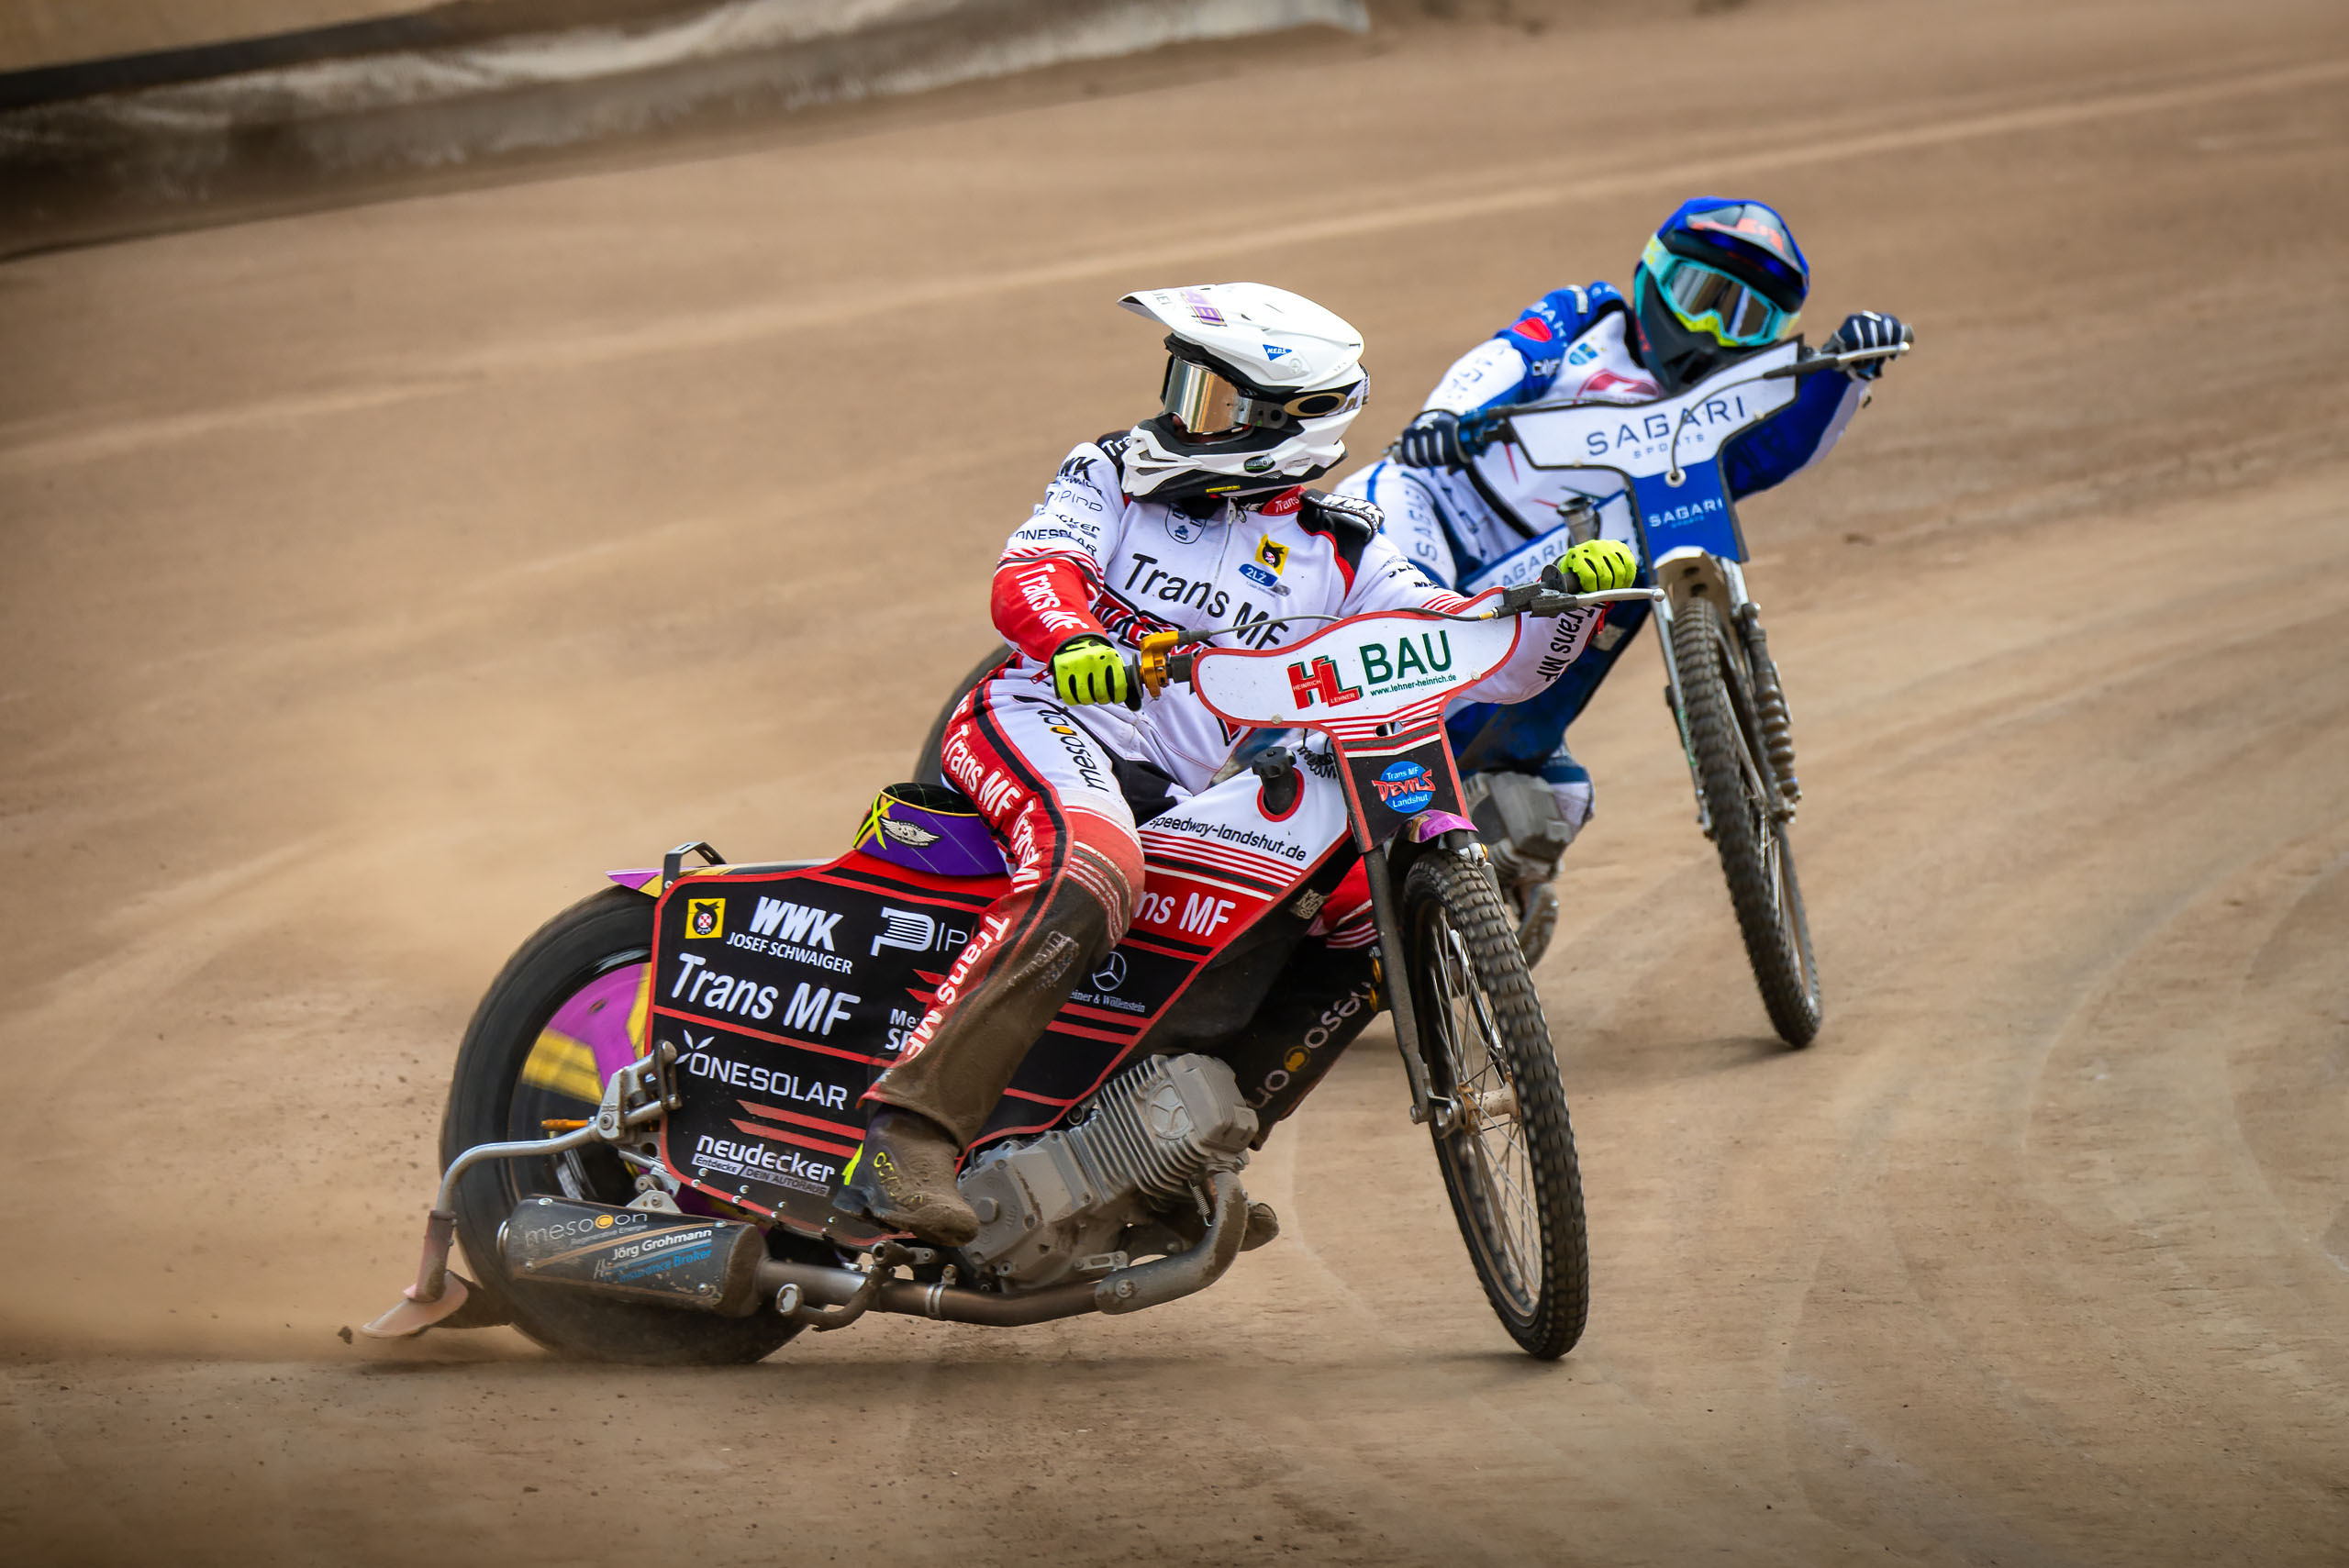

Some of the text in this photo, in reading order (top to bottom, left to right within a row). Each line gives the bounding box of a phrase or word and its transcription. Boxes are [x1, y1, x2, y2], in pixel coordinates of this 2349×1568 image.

[1586, 395, 1744, 456] SAGARI
[1101, 435, 1131, 457] Tra
[1275, 496, 1301, 513] Trans
[1648, 496, 1723, 528] SAGARI
[1489, 539, 1564, 587] AGARI
[1125, 552, 1230, 618] Trans
[1233, 601, 1289, 650] MF
[1359, 629, 1453, 686] BAU
[1292, 679, 1322, 691] HEINRICH
[1330, 693, 1356, 704] LEHNER
[1369, 673, 1457, 697] www.lehner-heinrich.de
[943, 724, 1021, 817] Trans MF
[1371, 769, 1437, 802] DEVILS
[1386, 766, 1419, 781] Trans MF
[1392, 794, 1429, 808] Landshut
[749, 895, 844, 951] WWK
[1179, 892, 1236, 937] MF
[726, 931, 853, 975] JOSEF SCHWAIGER
[938, 914, 1010, 1006] Trans
[672, 952, 862, 1036] Trans MF
[689, 1052, 848, 1110] ONESOLAR
[696, 1135, 835, 1183] neudecker
[746, 1168, 771, 1181] DEIN
[525, 1212, 648, 1248] mesocon
[612, 1229, 712, 1261] Jörg Grohmann
[673, 1250, 712, 1268] Broker
